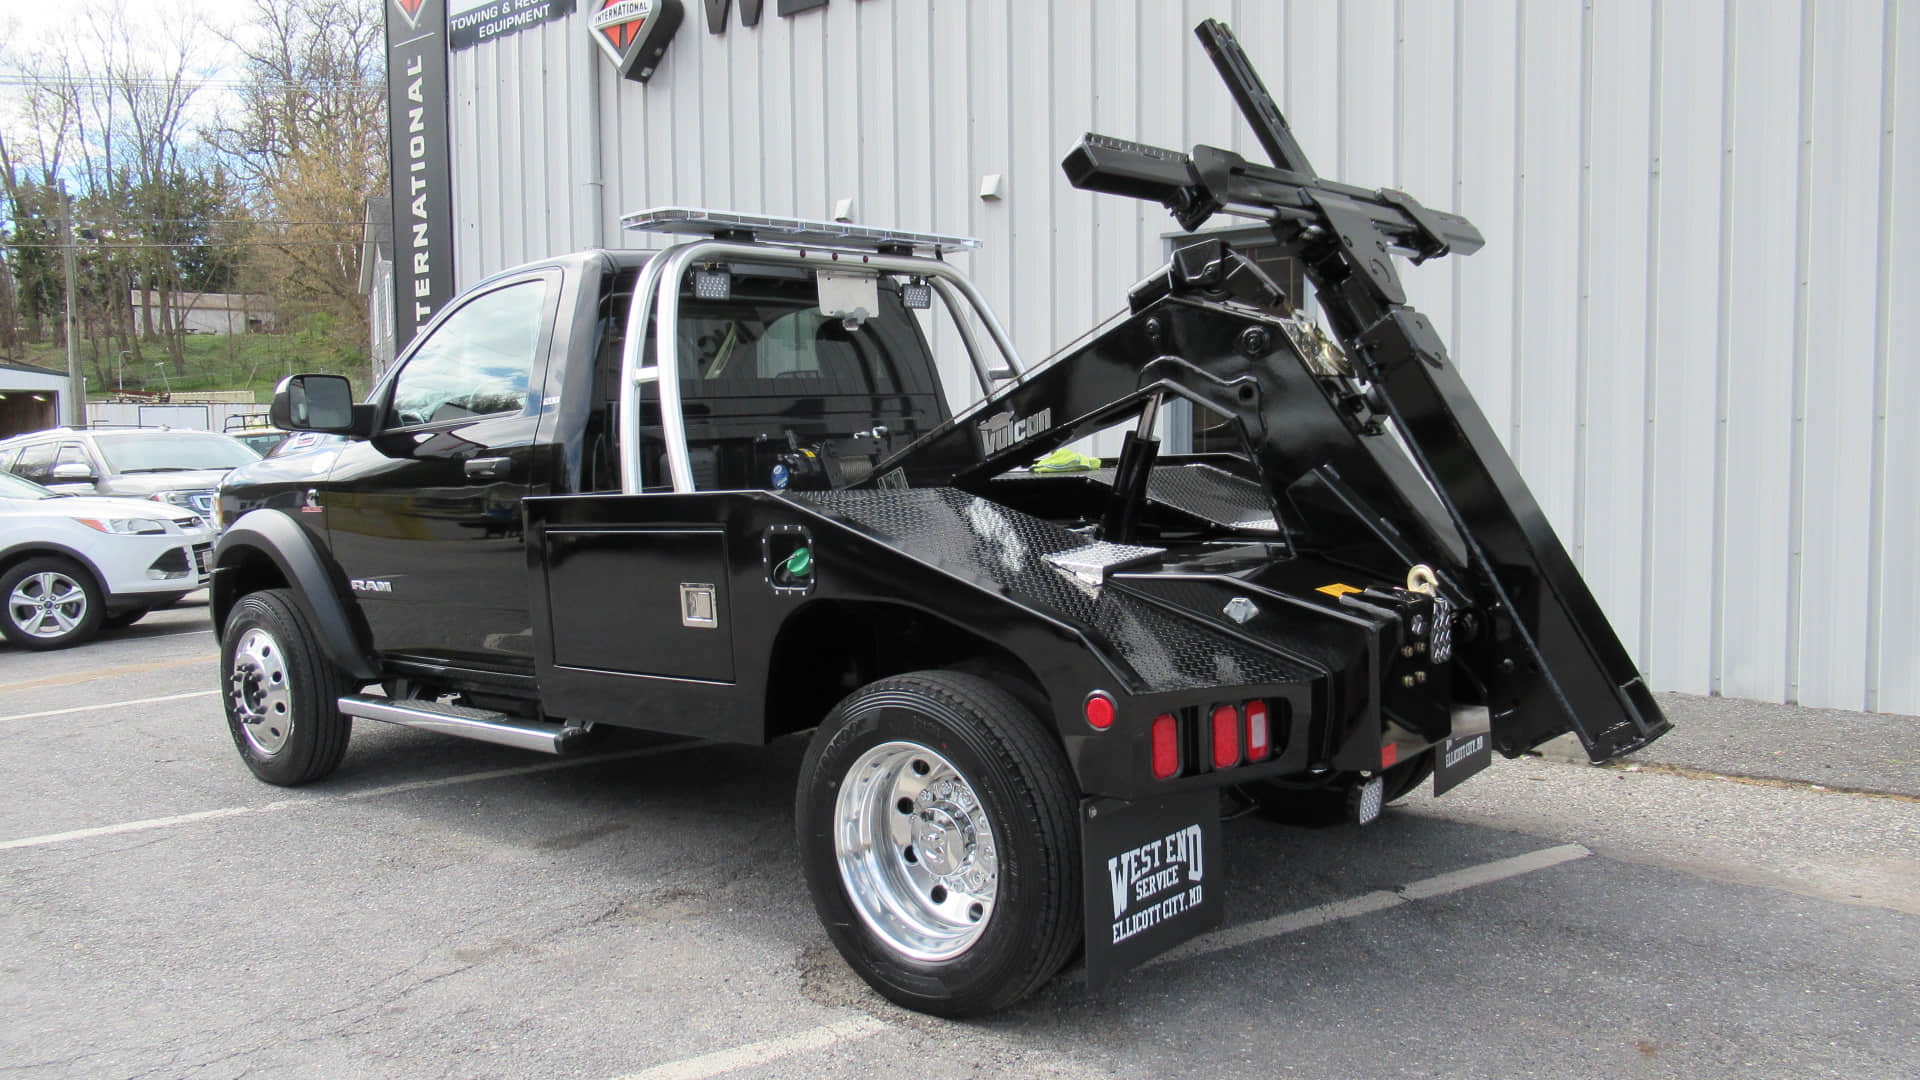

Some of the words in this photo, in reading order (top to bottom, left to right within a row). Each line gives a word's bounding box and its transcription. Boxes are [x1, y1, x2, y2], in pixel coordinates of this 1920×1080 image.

[451, 6, 498, 31] TOWING
[502, 2, 511, 14] &
[479, 4, 550, 38] EQUIPMENT
[595, 2, 648, 24] INTERNATIONAL
[351, 579, 392, 592] RAM
[1108, 839, 1162, 921] WEST
[1165, 823, 1203, 882] END
[1135, 864, 1180, 901] SERVICE
[1112, 903, 1162, 944] ELLICOTT
[1163, 892, 1188, 919] CITY,
[1189, 884, 1203, 908] MD
